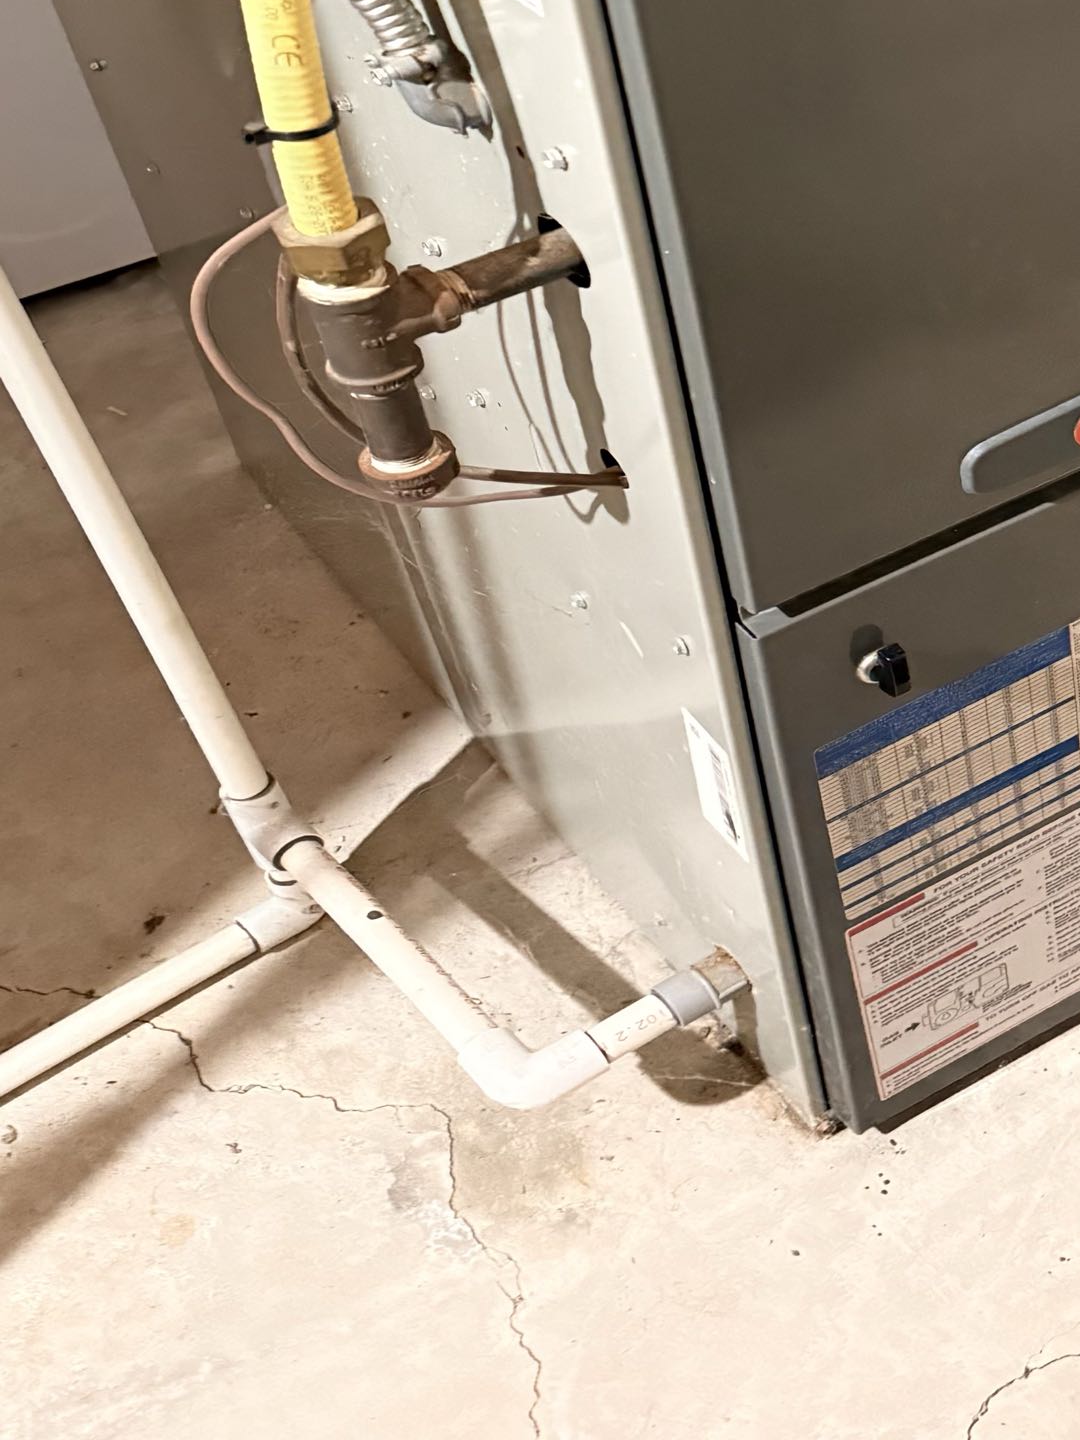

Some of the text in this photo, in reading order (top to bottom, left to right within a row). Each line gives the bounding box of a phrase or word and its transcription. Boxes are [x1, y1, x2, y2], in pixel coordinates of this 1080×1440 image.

[272, 34, 302, 68] CE
[933, 878, 951, 893] FOR
[954, 864, 978, 881] YOUR
[981, 845, 1014, 868] SAFETY
[1018, 832, 1039, 848] READ
[1041, 814, 1075, 836] BEFORE
